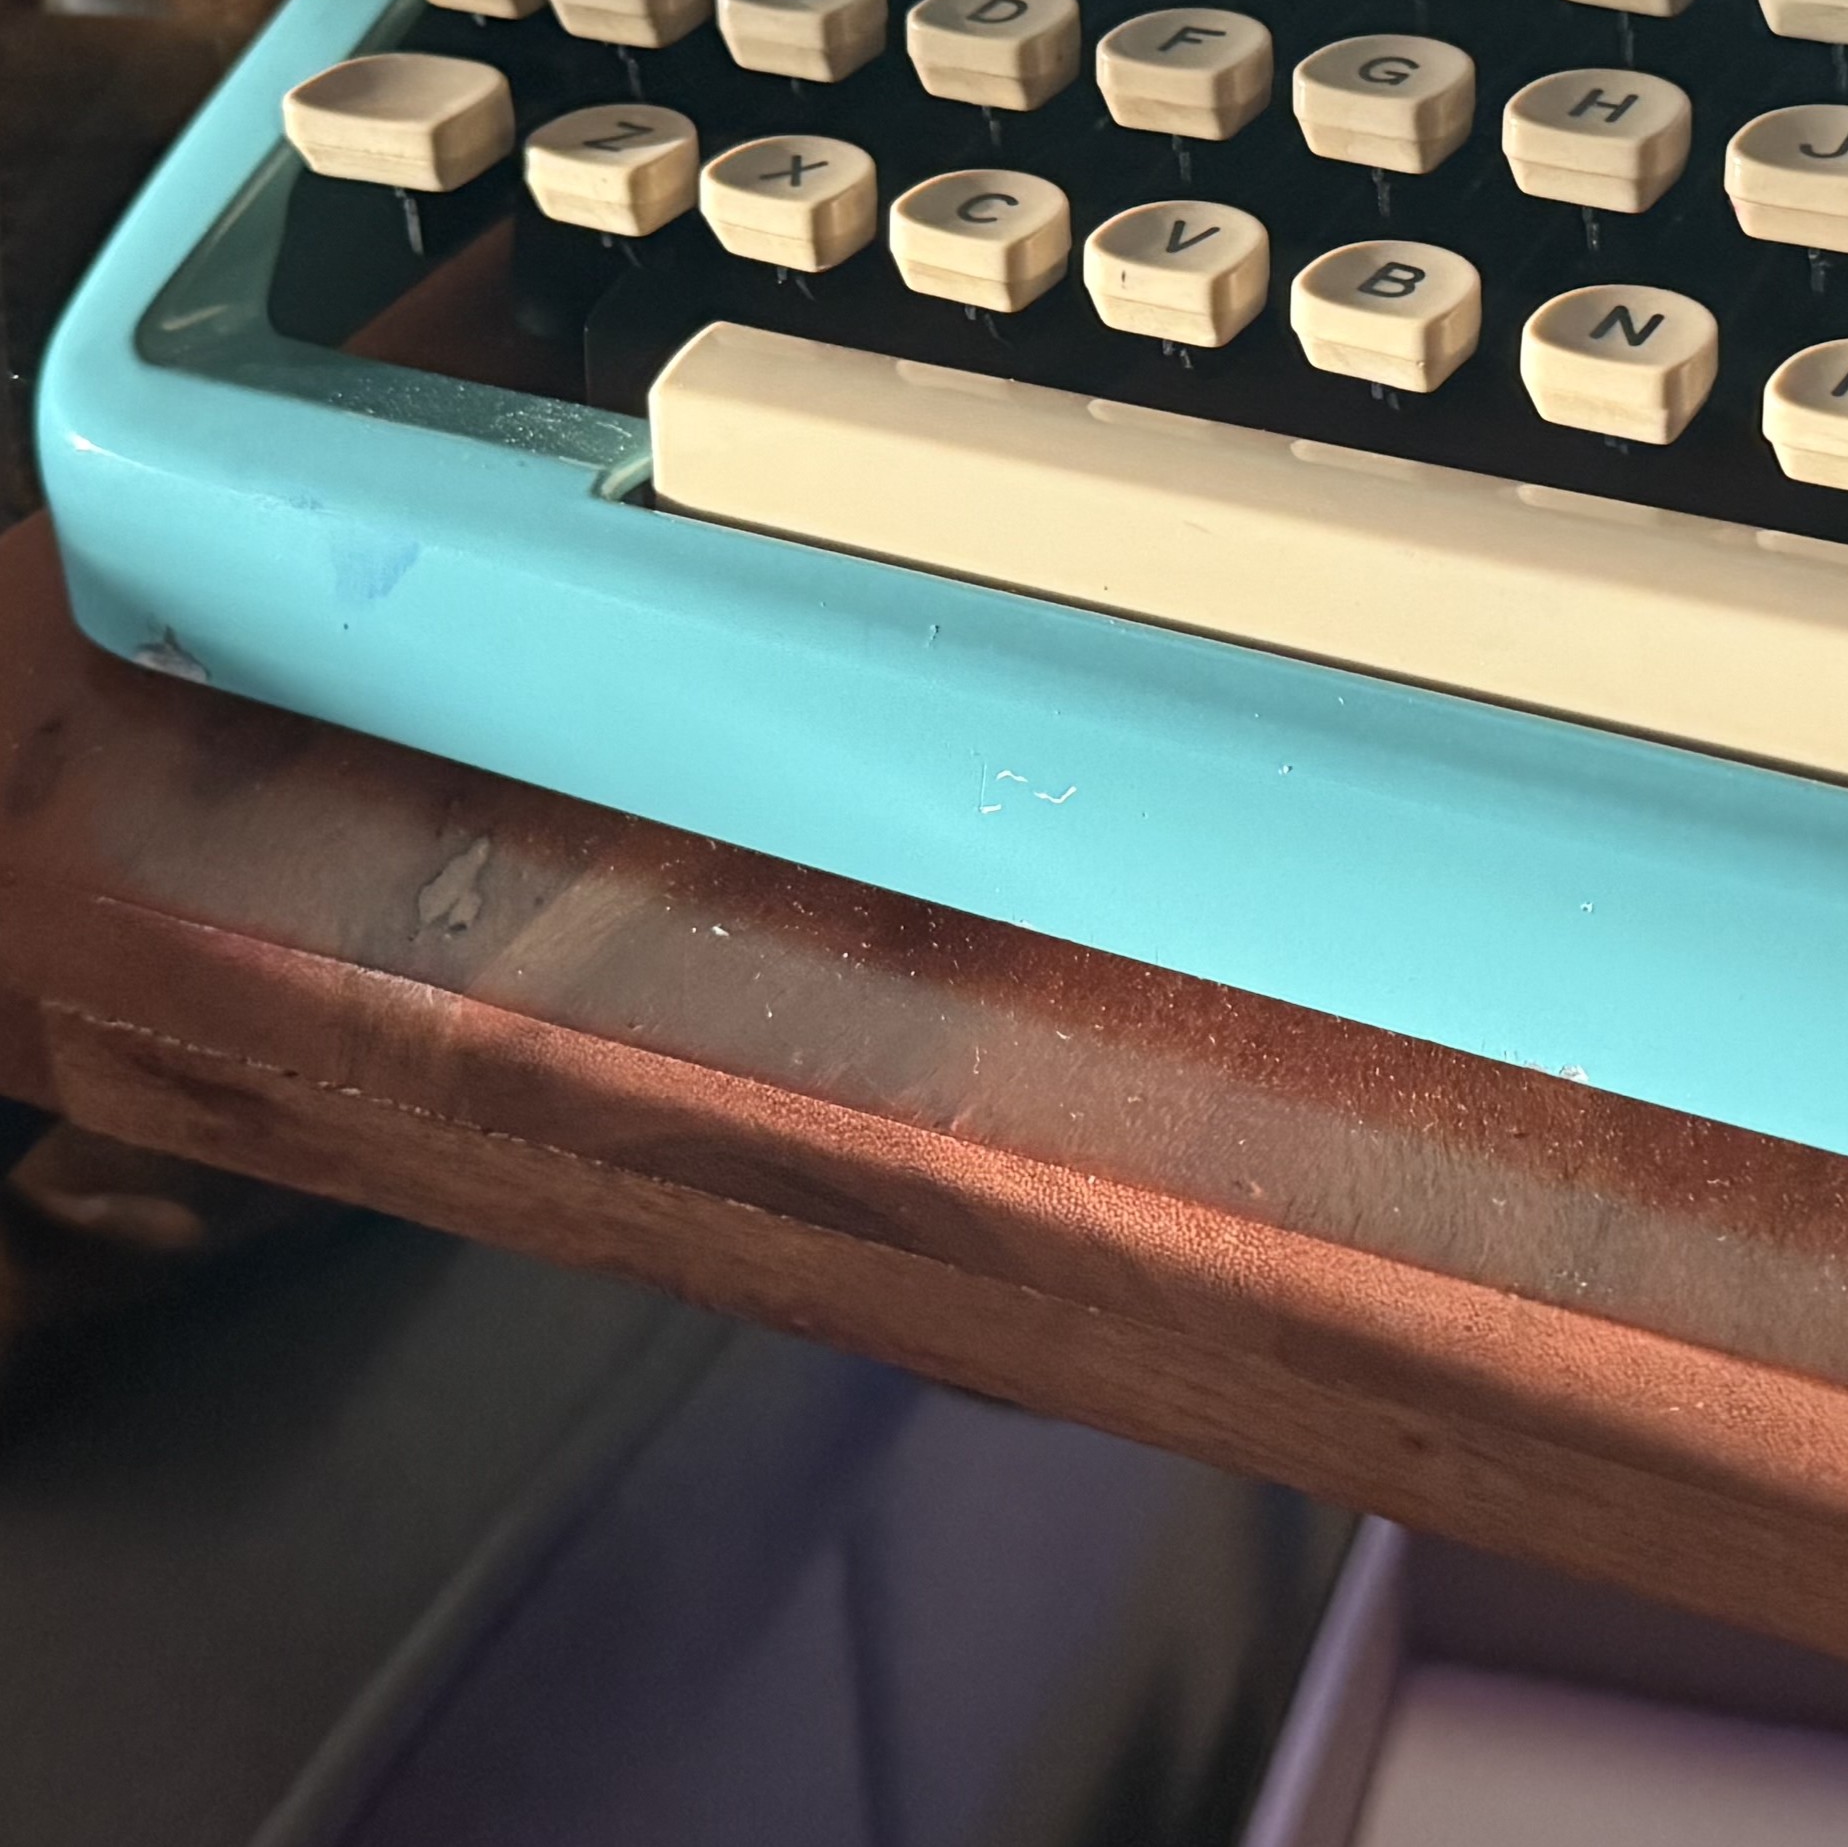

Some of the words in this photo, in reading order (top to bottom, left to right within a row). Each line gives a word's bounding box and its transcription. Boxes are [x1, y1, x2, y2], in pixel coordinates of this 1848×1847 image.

[1158, 26, 1227, 52] F
[1358, 56, 1420, 85] G
[1568, 88, 1639, 123] H
[583, 121, 655, 153] Z
[758, 155, 829, 187] X
[957, 193, 1020, 224] C
[1165, 219, 1221, 254] V
[1357, 262, 1426, 299] B
[1589, 305, 1665, 347] N
